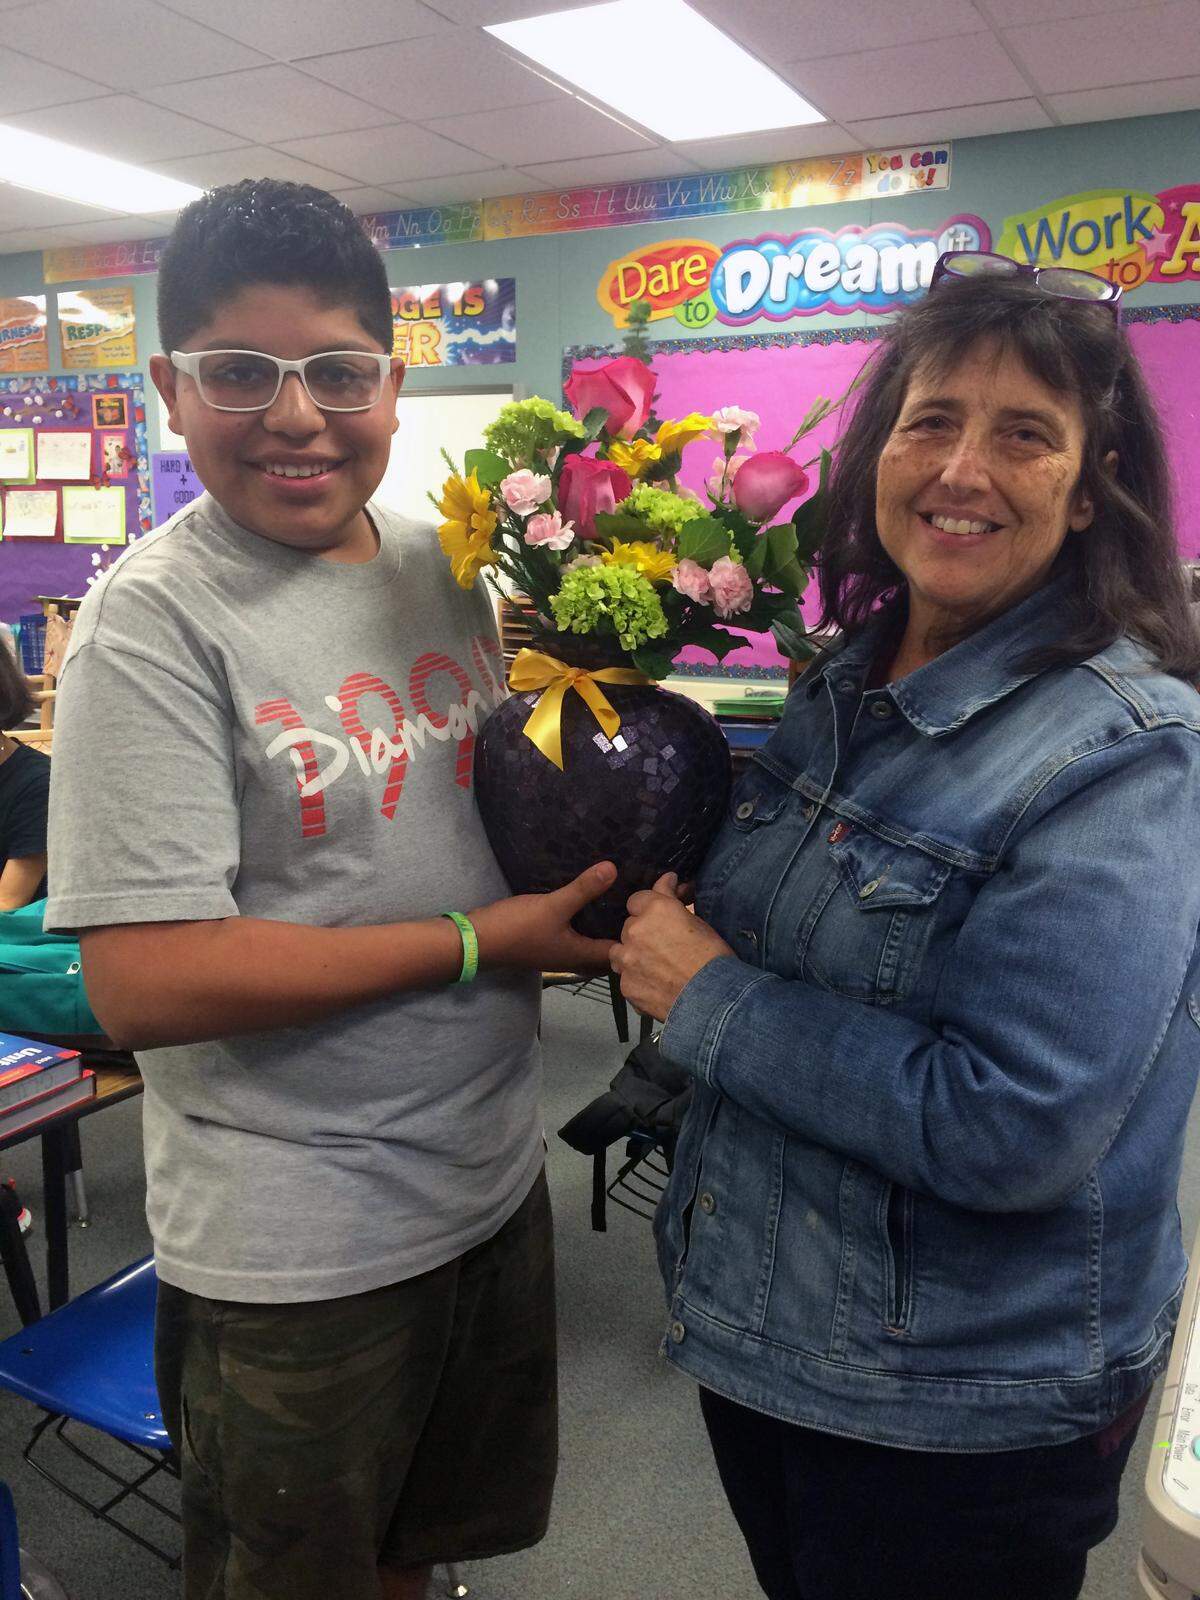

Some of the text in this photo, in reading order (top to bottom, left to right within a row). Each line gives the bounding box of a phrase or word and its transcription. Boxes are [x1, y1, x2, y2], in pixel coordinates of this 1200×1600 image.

[867, 150, 948, 174] You can
[396, 213, 421, 236] Nn
[428, 208, 451, 233] Oo
[460, 206, 481, 239] Pp
[557, 194, 580, 219] Ss
[592, 188, 616, 216] Tt
[624, 185, 657, 211] Uu
[666, 180, 691, 207] Vv
[700, 176, 738, 203] Ww
[741, 168, 773, 197] Xx
[828, 159, 856, 189] Zz
[1017, 196, 1154, 264] Work
[617, 228, 971, 324] Dare to Dream it
[1106, 257, 1142, 286] to
[160, 460, 181, 473] HARD
